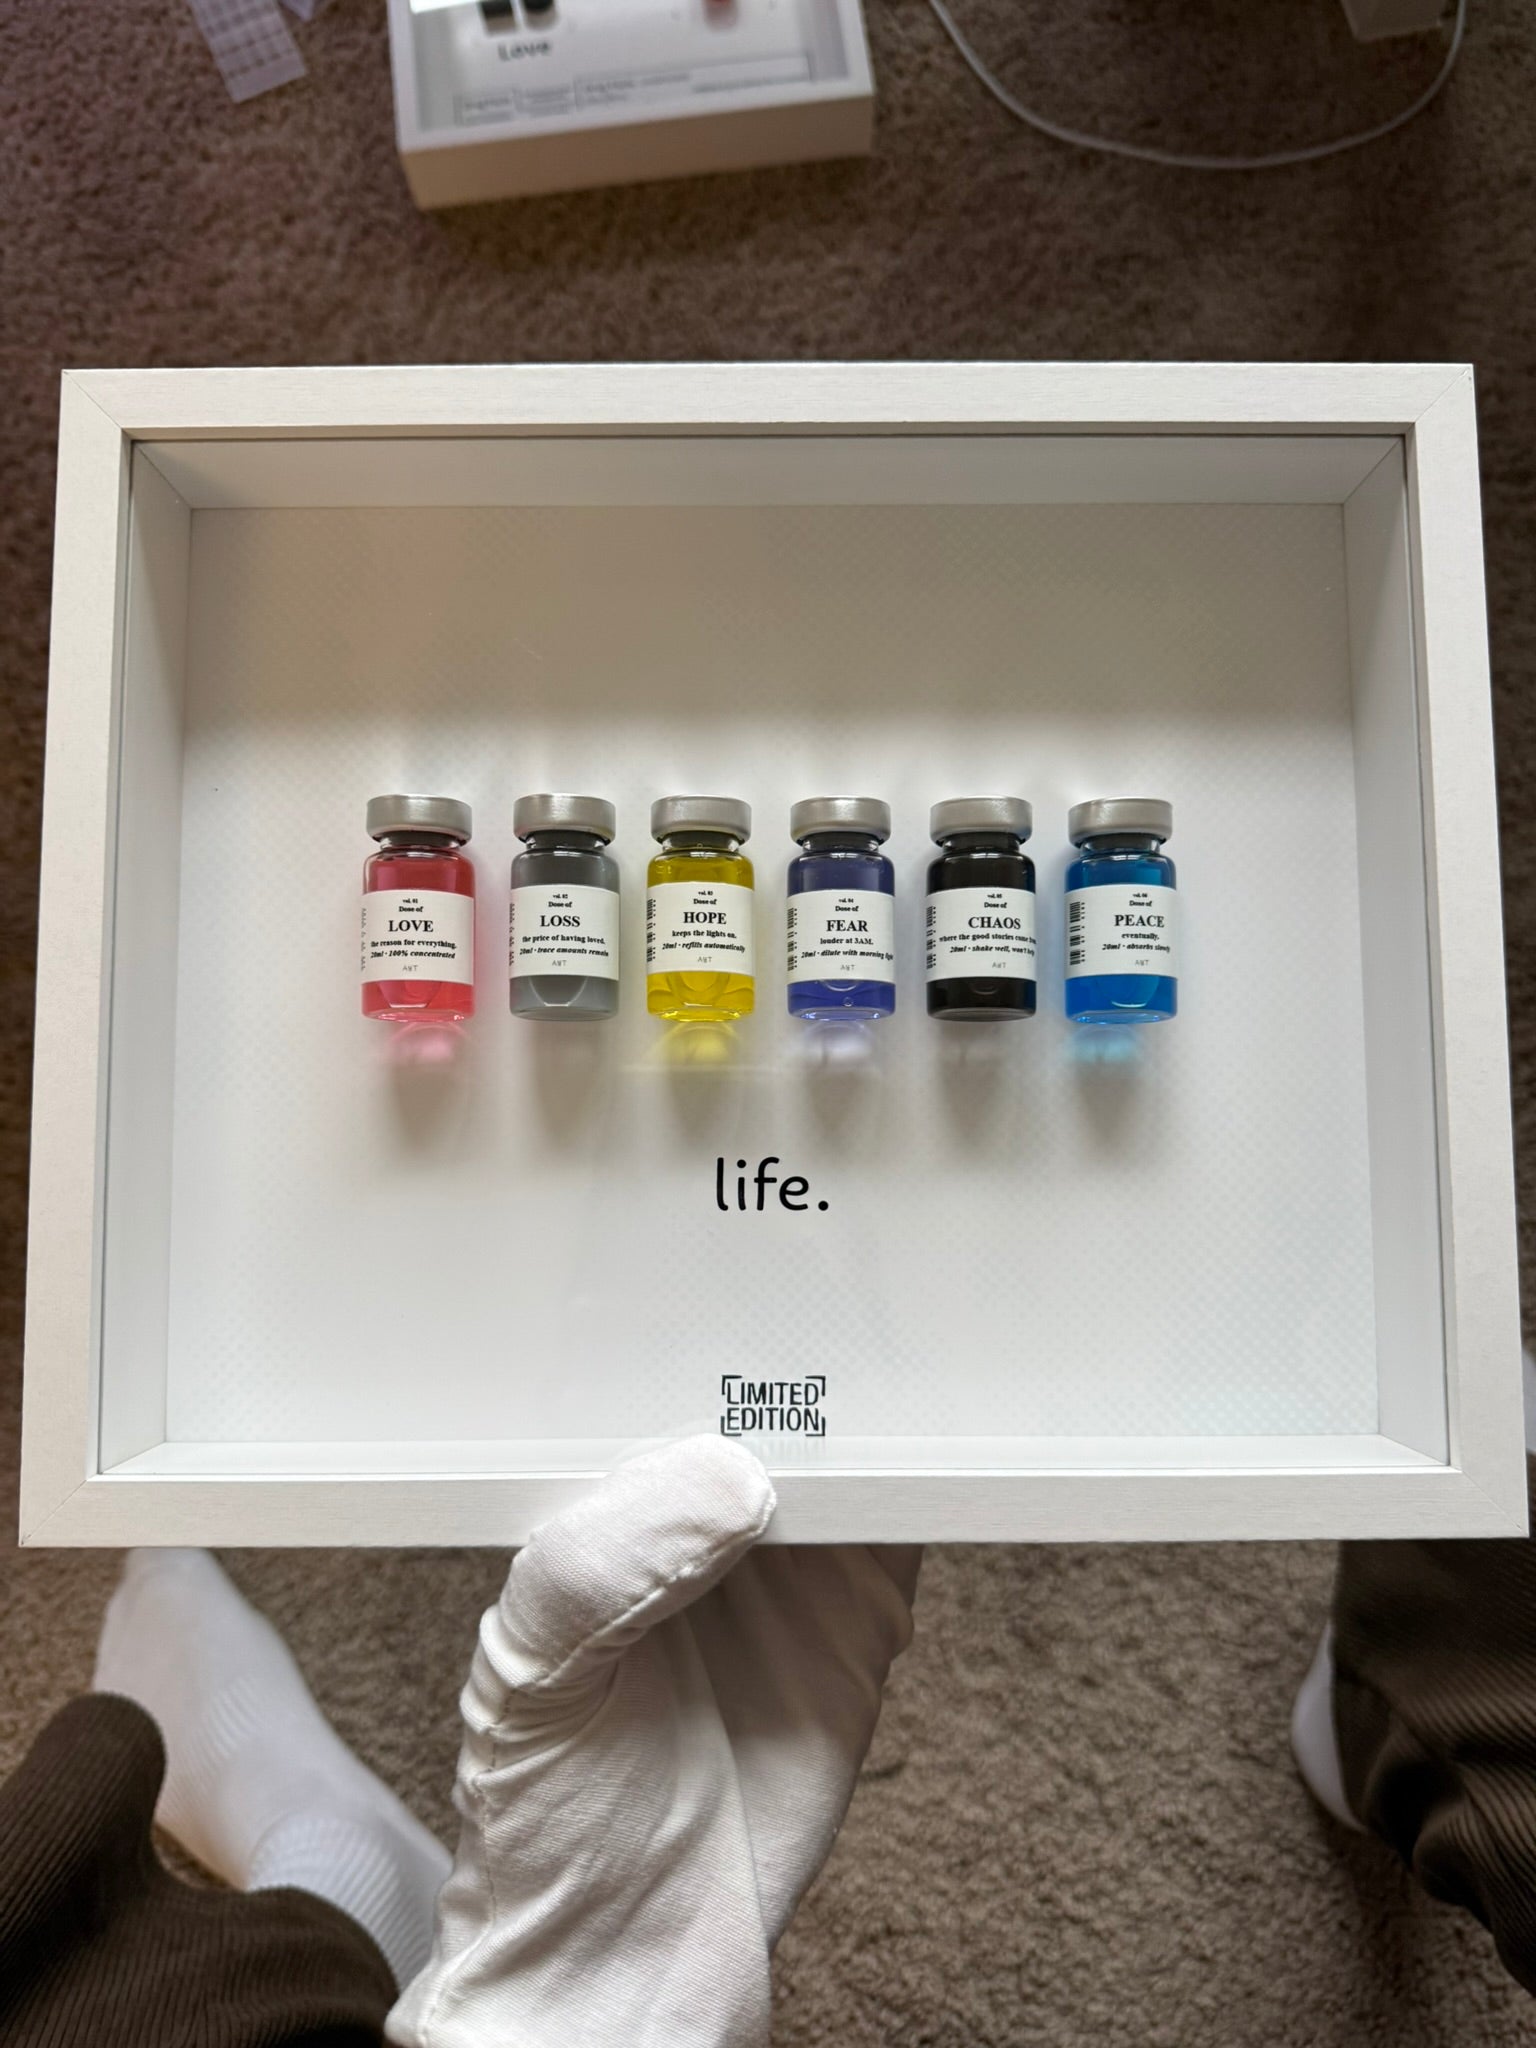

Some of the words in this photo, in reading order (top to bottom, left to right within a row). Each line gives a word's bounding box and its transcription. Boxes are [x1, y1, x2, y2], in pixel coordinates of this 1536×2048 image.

[540, 915, 580, 927] LOSS
[684, 912, 727, 924] HOPE
[968, 917, 1021, 929] CHAOS
[1114, 915, 1165, 928] PEACE
[388, 920, 434, 932] LOVE
[826, 920, 868, 932] FEAR
[704, 943, 745, 953] automatically
[410, 951, 455, 959] concentrated
[859, 951, 884, 959] morning
[716, 1156, 829, 1211] life.
[726, 1382, 819, 1405] LIMITED
[726, 1407, 820, 1431] EDITION
